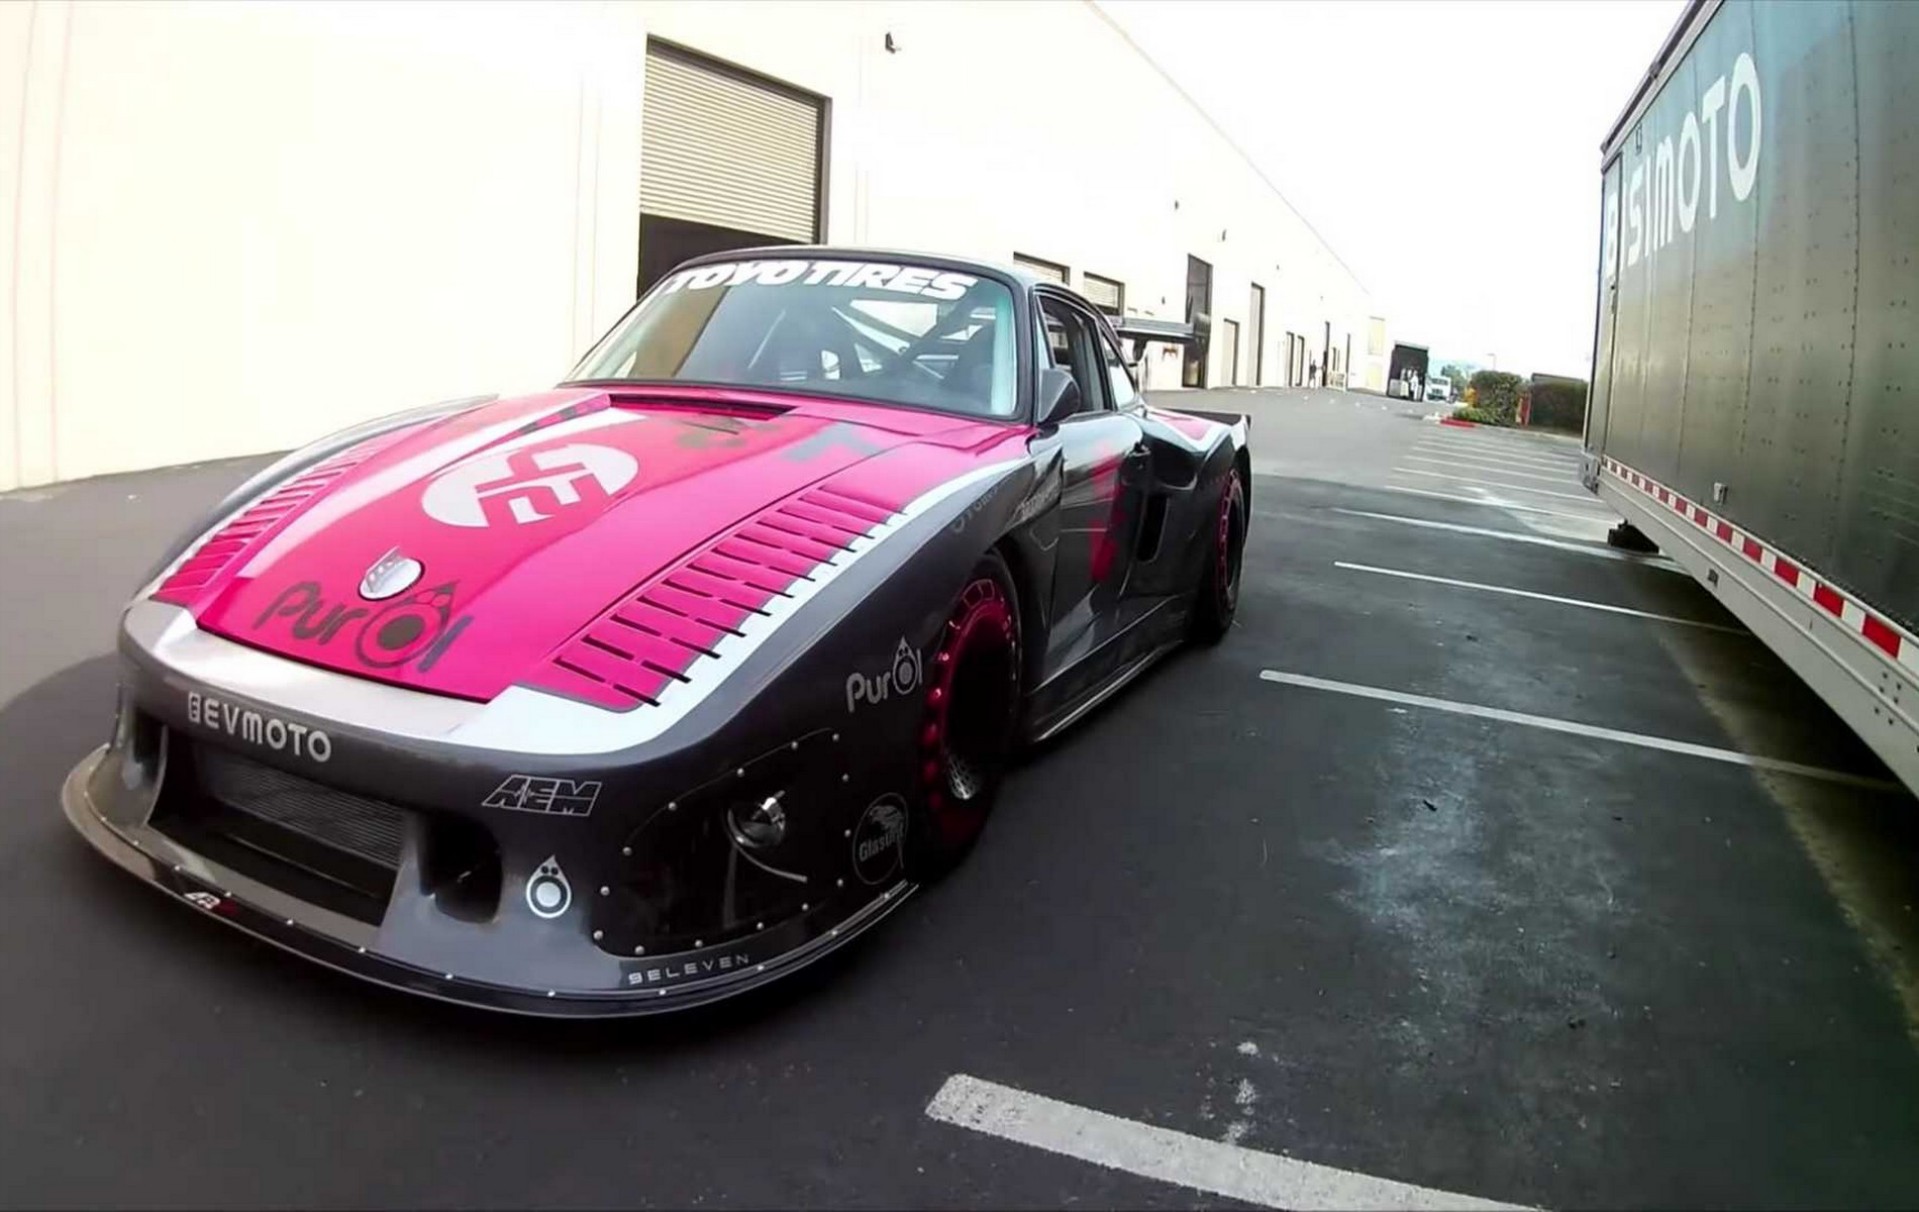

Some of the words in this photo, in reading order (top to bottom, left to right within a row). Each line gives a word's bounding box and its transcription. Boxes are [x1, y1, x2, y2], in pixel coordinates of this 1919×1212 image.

[1606, 52, 1761, 278] BISIMOTO
[663, 259, 810, 294] TOYO
[803, 260, 978, 300] TIRES
[481, 773, 602, 817] AEM
